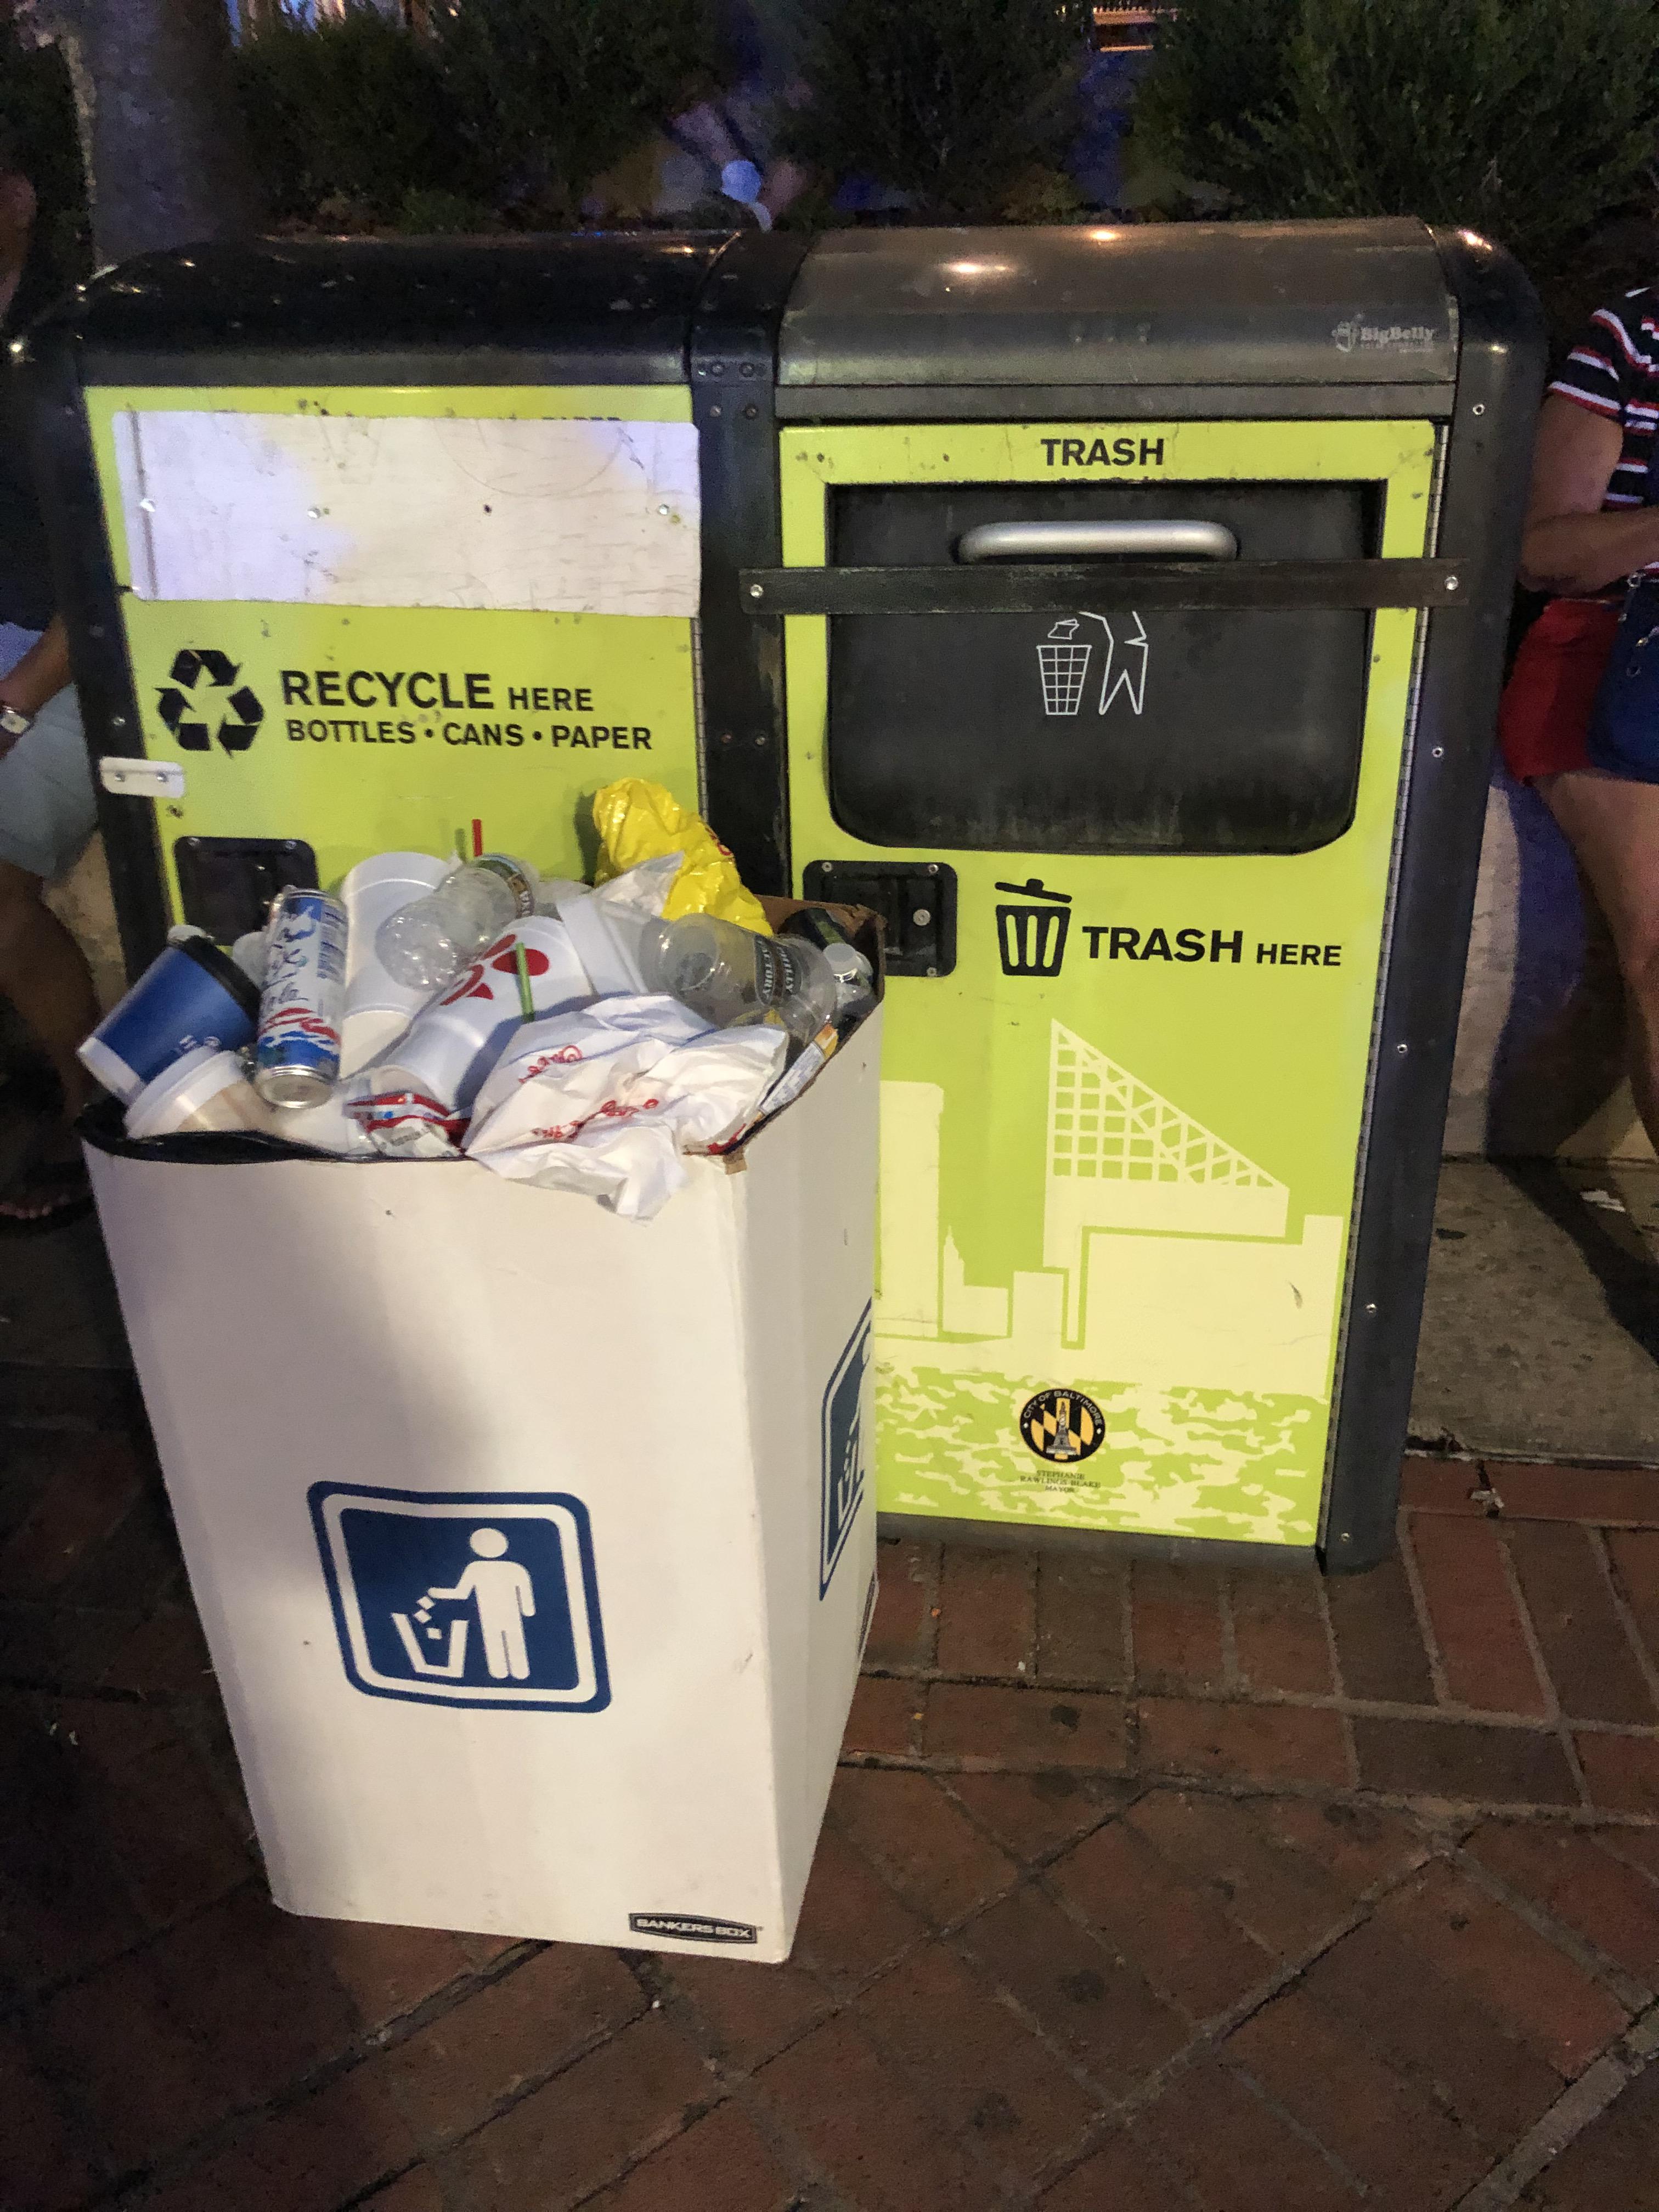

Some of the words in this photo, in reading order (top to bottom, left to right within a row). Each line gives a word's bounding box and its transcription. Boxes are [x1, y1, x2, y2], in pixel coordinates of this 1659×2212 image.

[1041, 438, 1164, 466] TRASH
[280, 670, 495, 710] RECYCLE
[508, 687, 594, 712] HERE
[285, 719, 416, 744] BOTTLES
[442, 723, 524, 747] CANS
[551, 726, 653, 750] PAPER
[1081, 926, 1243, 963] TRASH
[1256, 943, 1342, 967] HERE
[1023, 1399, 1038, 1419] CITY
[1038, 1392, 1051, 1402] OF
[1053, 1390, 1103, 1426] BALTIMORE
[635, 1918, 714, 1933] BANKERS
[715, 1926, 752, 1938] BOX
